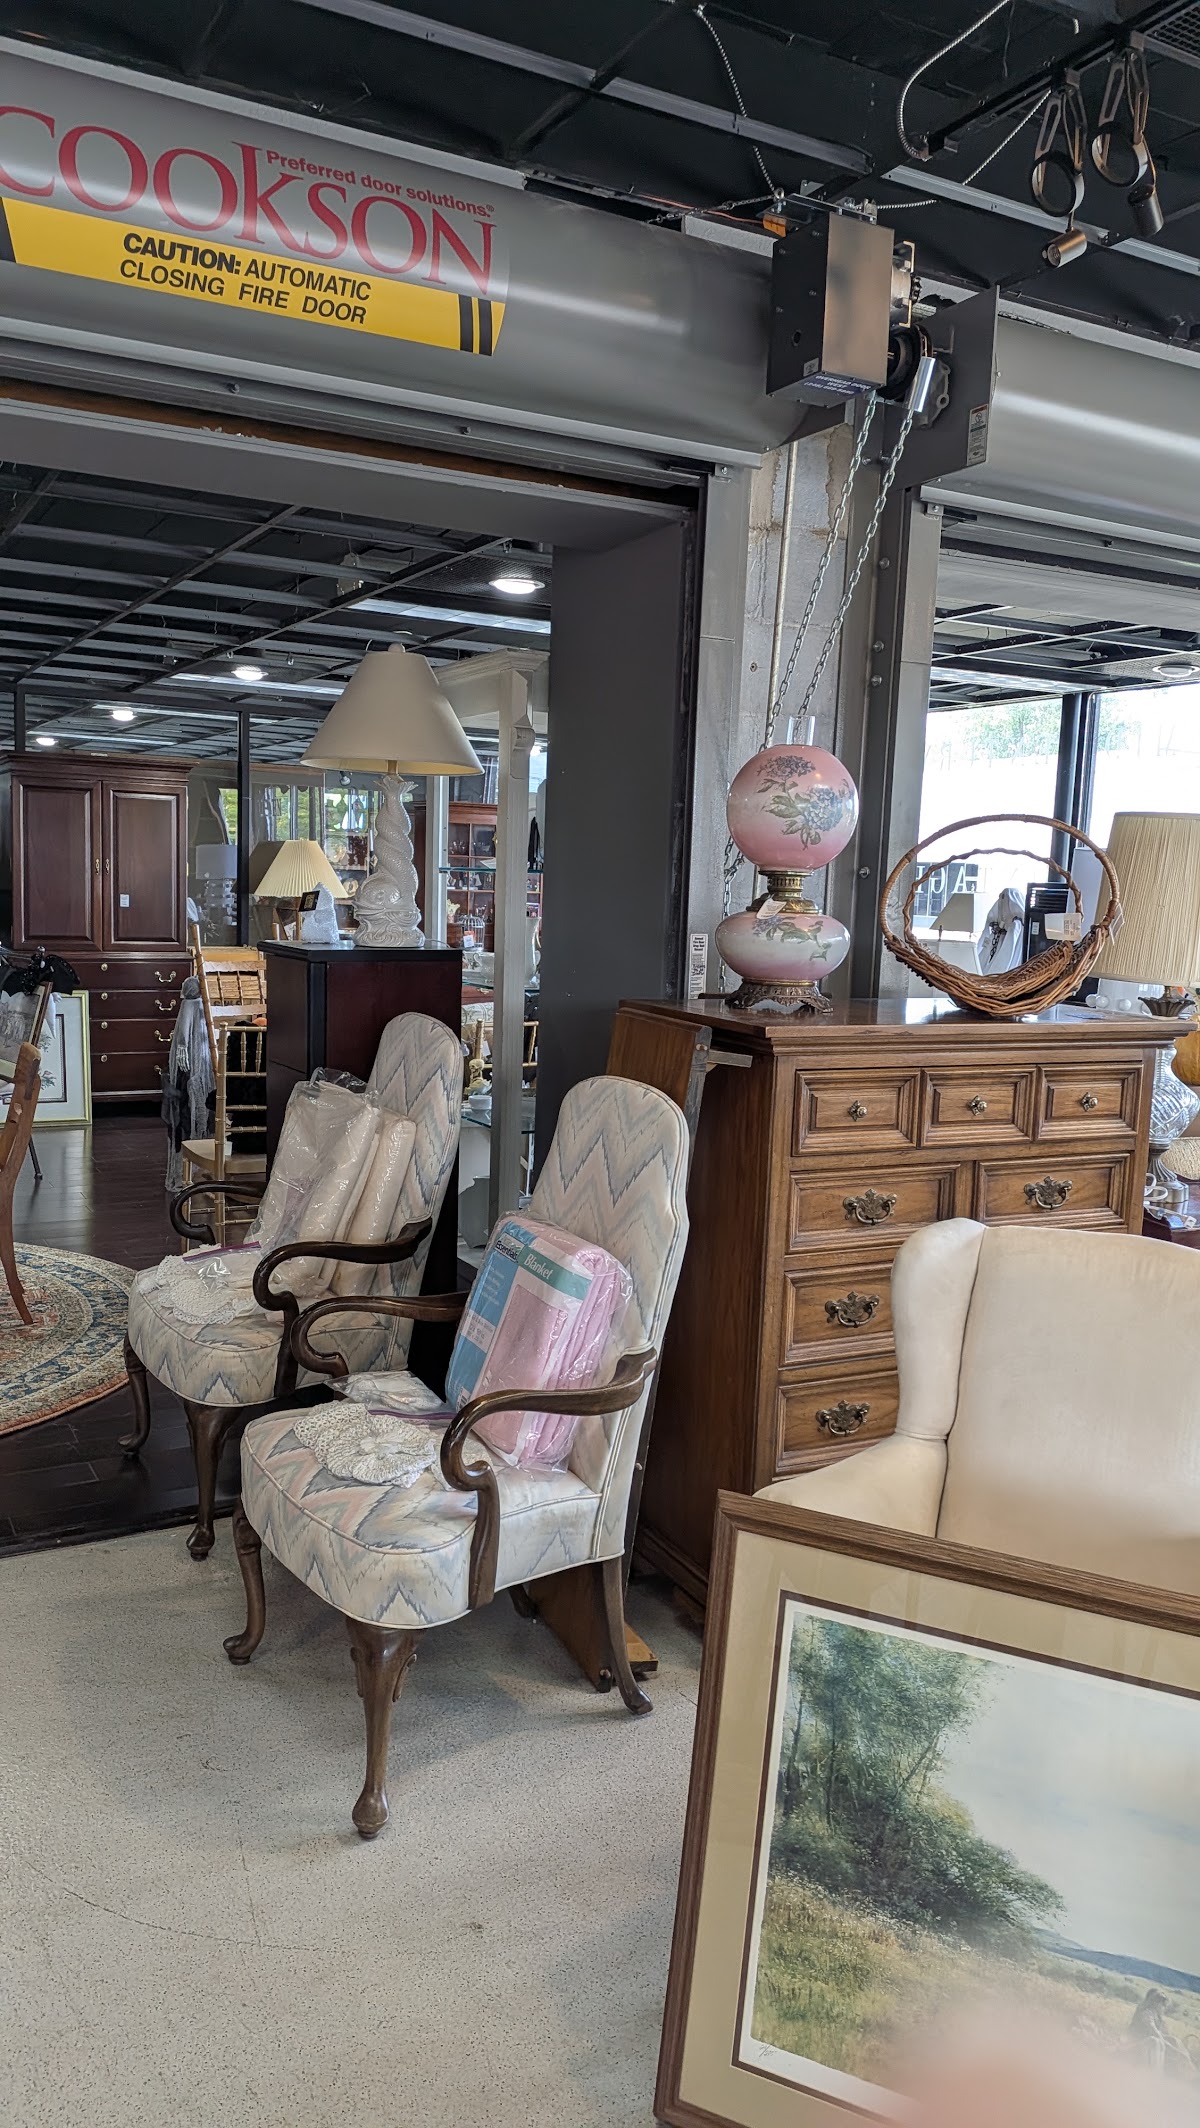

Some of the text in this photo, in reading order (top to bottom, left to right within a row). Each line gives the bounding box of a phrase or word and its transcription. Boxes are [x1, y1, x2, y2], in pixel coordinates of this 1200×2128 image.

[0, 106, 498, 295] COOKSON
[266, 150, 358, 185] Preferred
[361, 172, 402, 196] door
[120, 259, 367, 324] CLOSING FIRE DOOR
[123, 232, 372, 301] CAUTION: AUTOMATIC
[524, 1253, 554, 1280] Blanket
